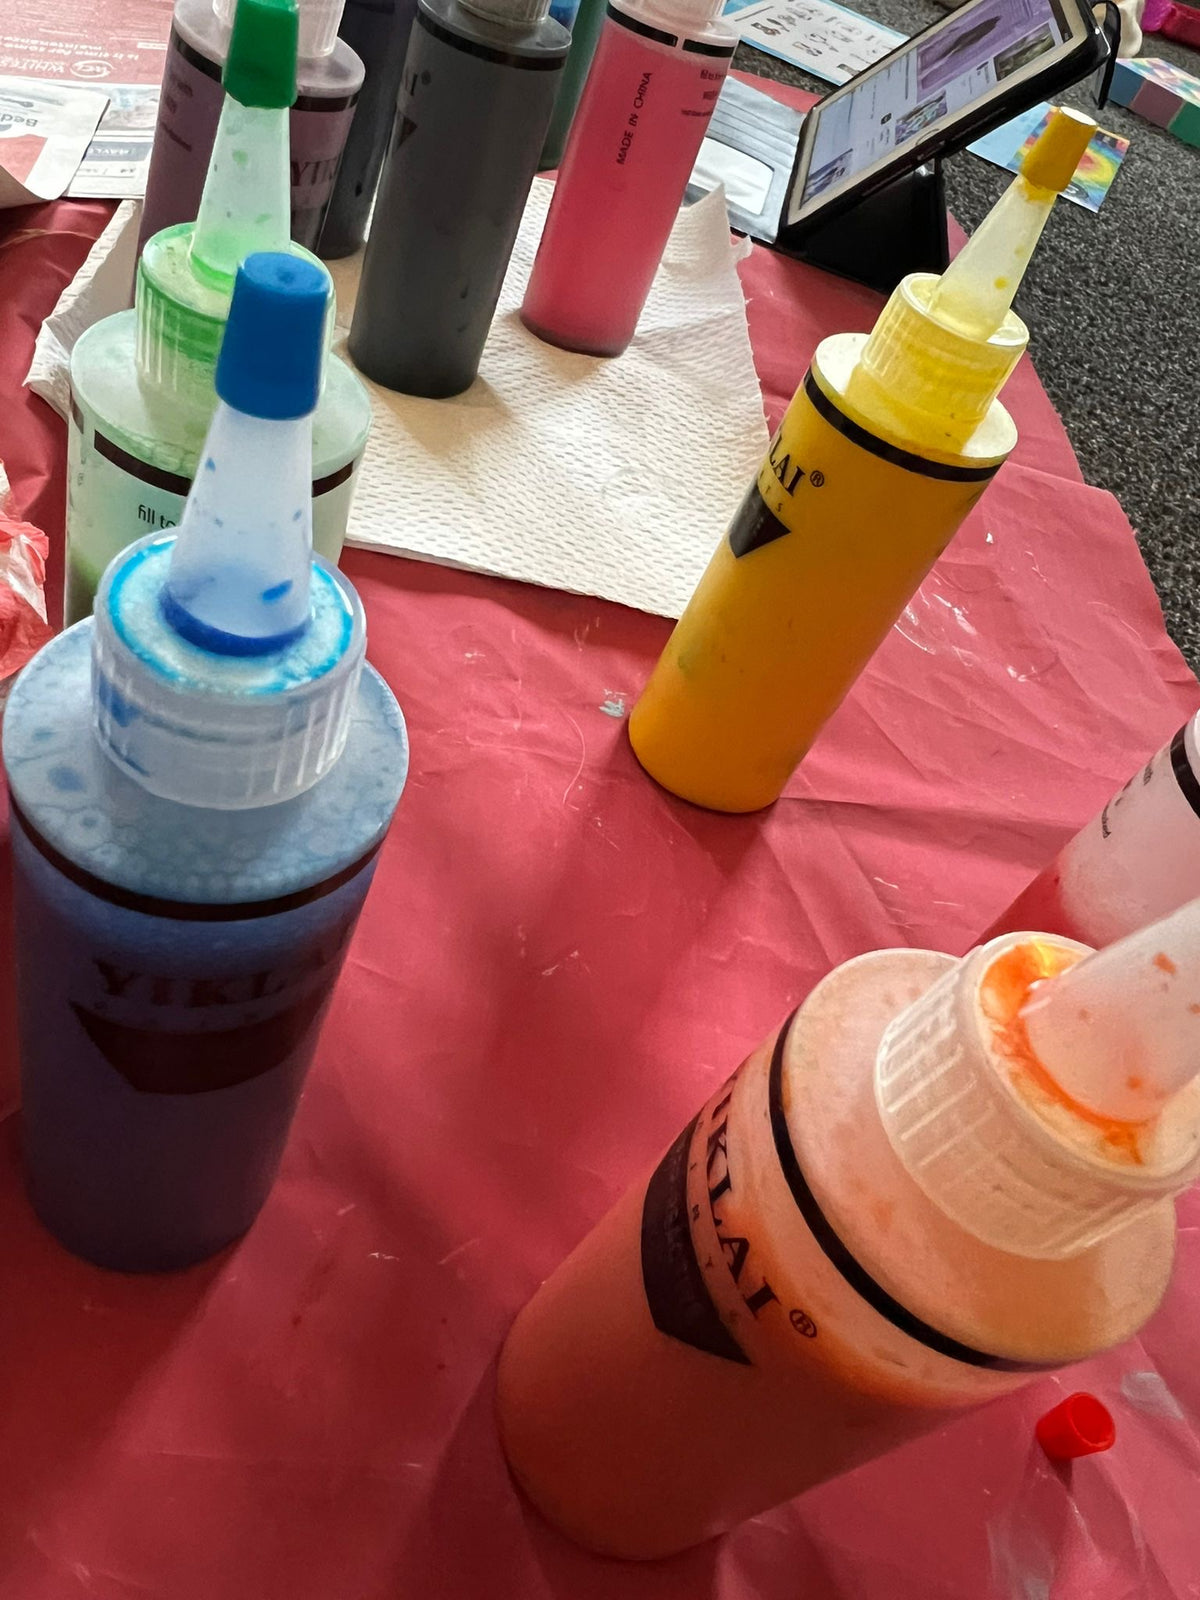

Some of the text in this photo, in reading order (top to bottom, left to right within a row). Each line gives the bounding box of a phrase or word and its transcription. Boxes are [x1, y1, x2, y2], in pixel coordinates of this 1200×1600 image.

[615, 72, 653, 165] MADE IN CHINA
[138, 504, 155, 525] fill
